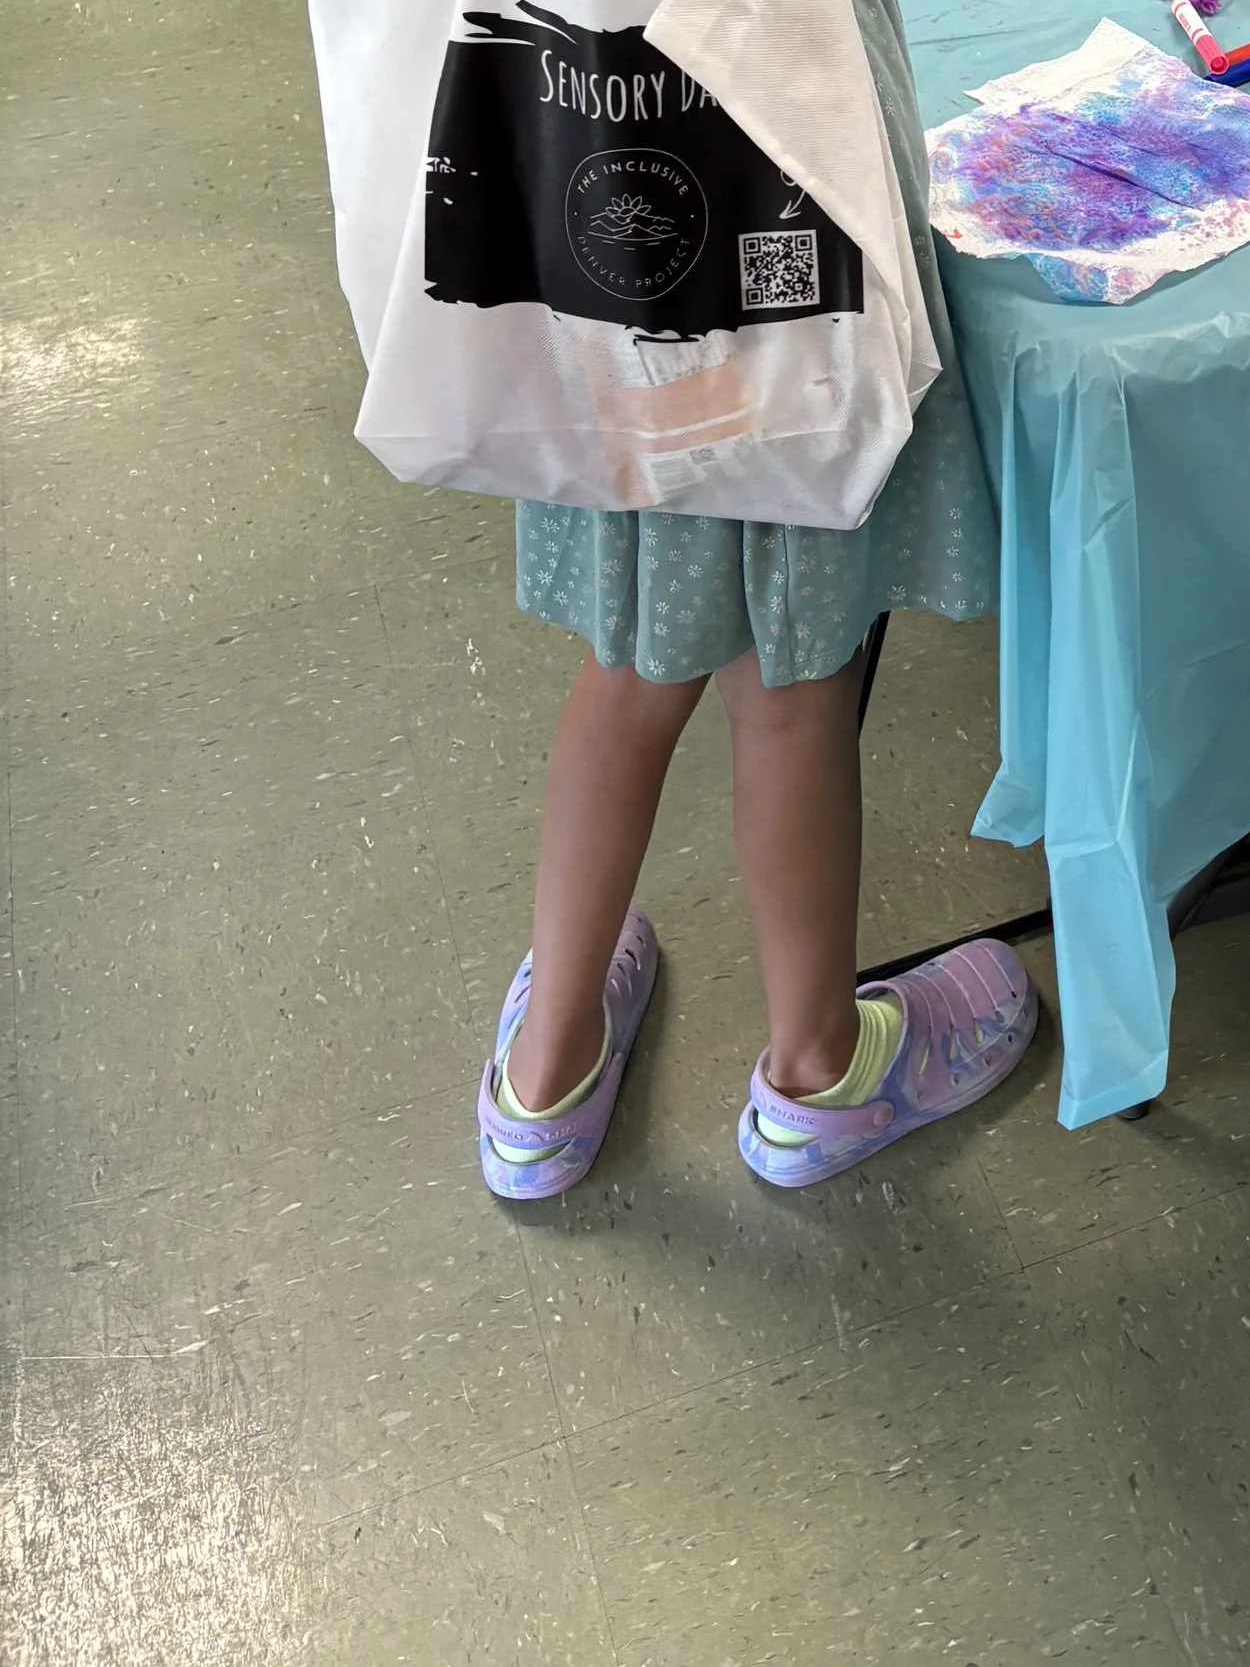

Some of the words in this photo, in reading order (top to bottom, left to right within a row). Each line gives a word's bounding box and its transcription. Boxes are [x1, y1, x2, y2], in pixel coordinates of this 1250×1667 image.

[539, 49, 666, 123] SENSORY
[577, 170, 599, 194] THE
[602, 161, 690, 196] INCLUSIVE
[576, 236, 626, 286] DENVER
[635, 238, 691, 288] PROJECT
